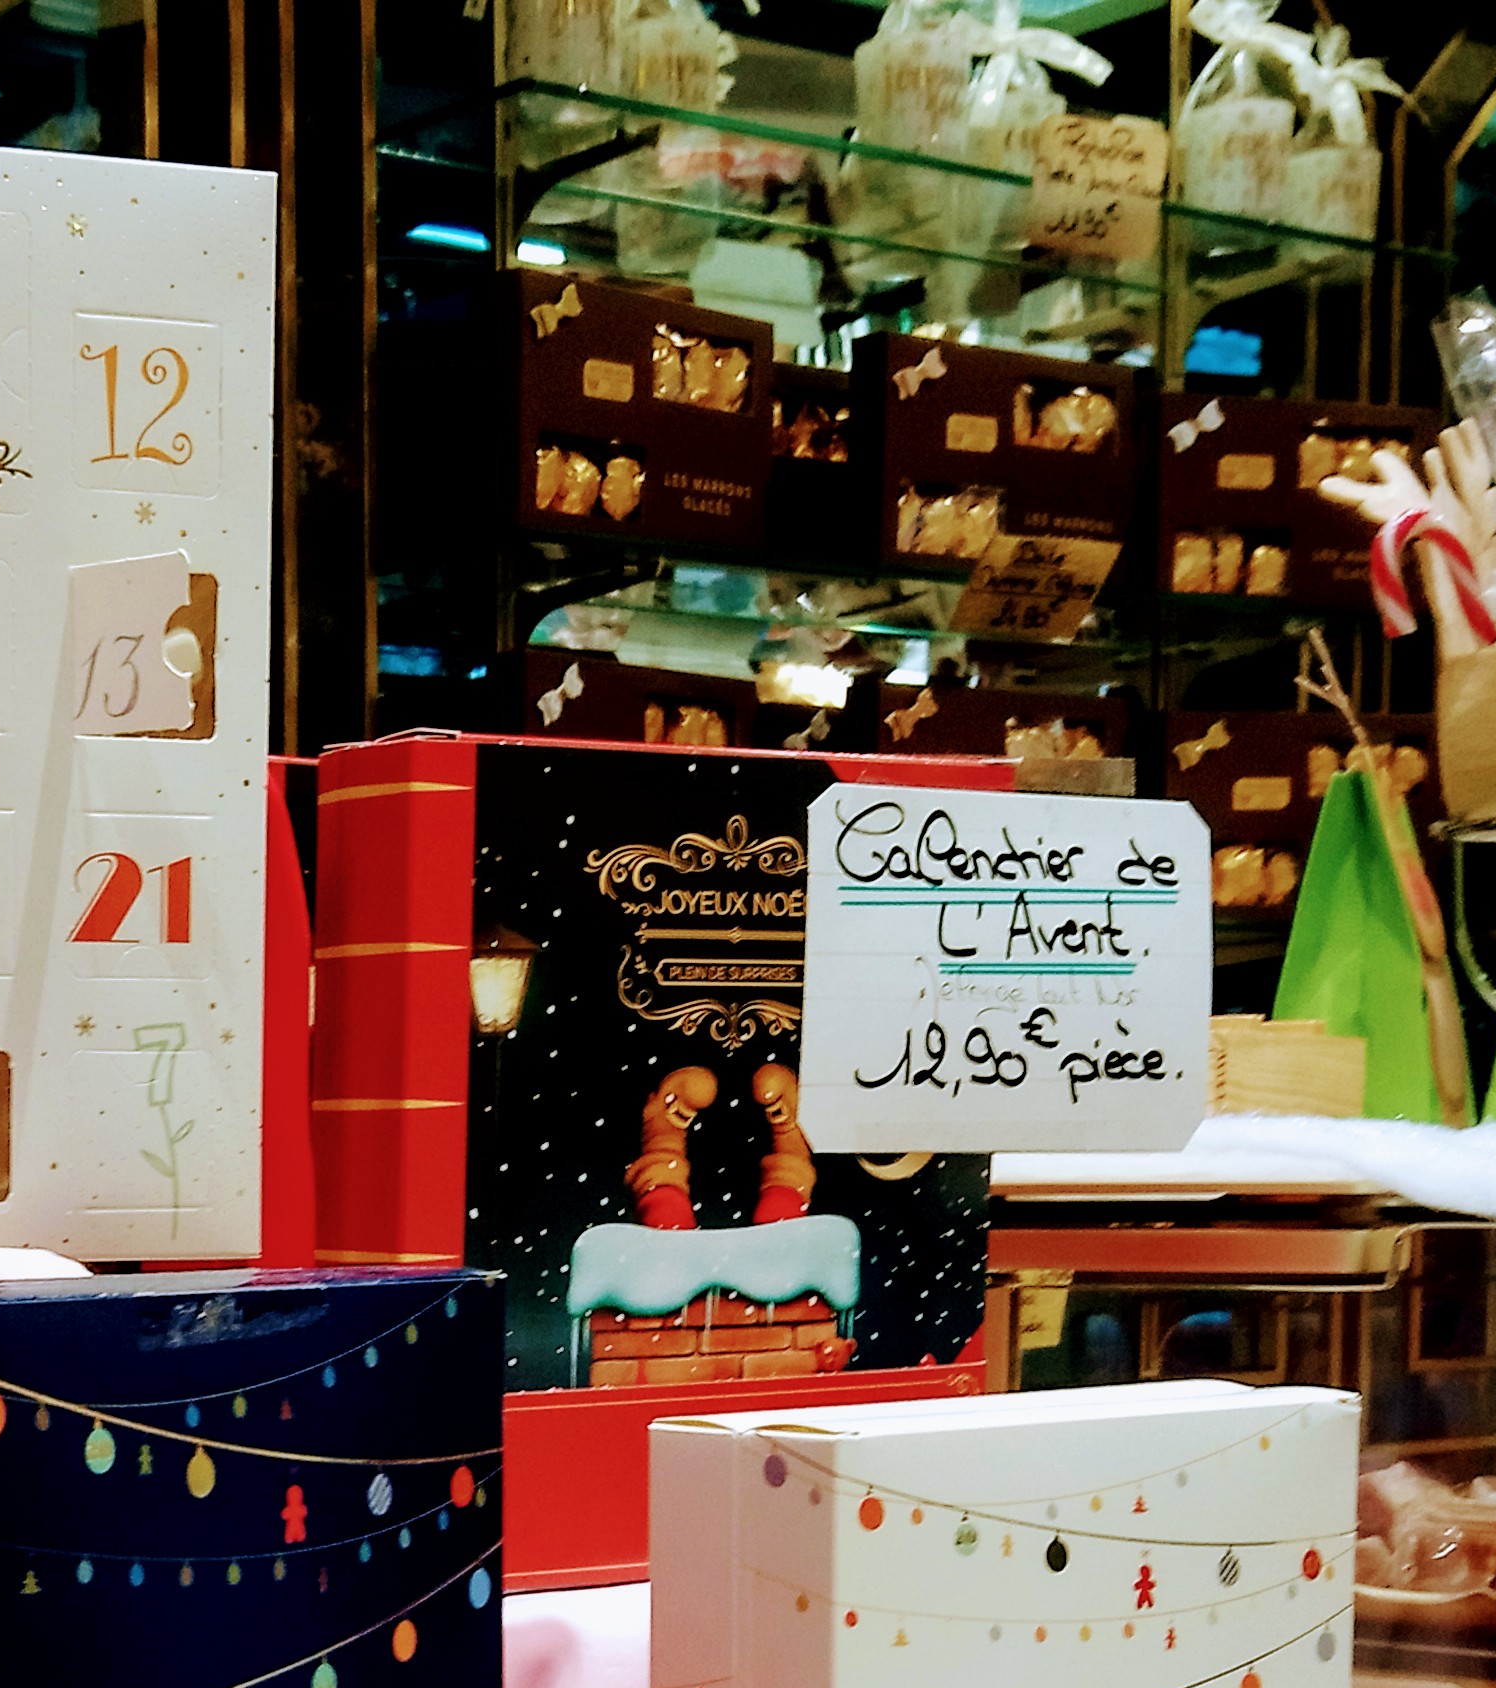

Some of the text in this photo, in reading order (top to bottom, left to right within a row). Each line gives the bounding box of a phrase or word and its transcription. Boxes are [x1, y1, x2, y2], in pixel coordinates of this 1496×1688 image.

[79, 344, 194, 466] 12
[73, 635, 145, 721] 13
[835, 799, 1179, 886] Calendrier de
[66, 851, 192, 944] 21
[656, 889, 749, 916] JOYEUX
